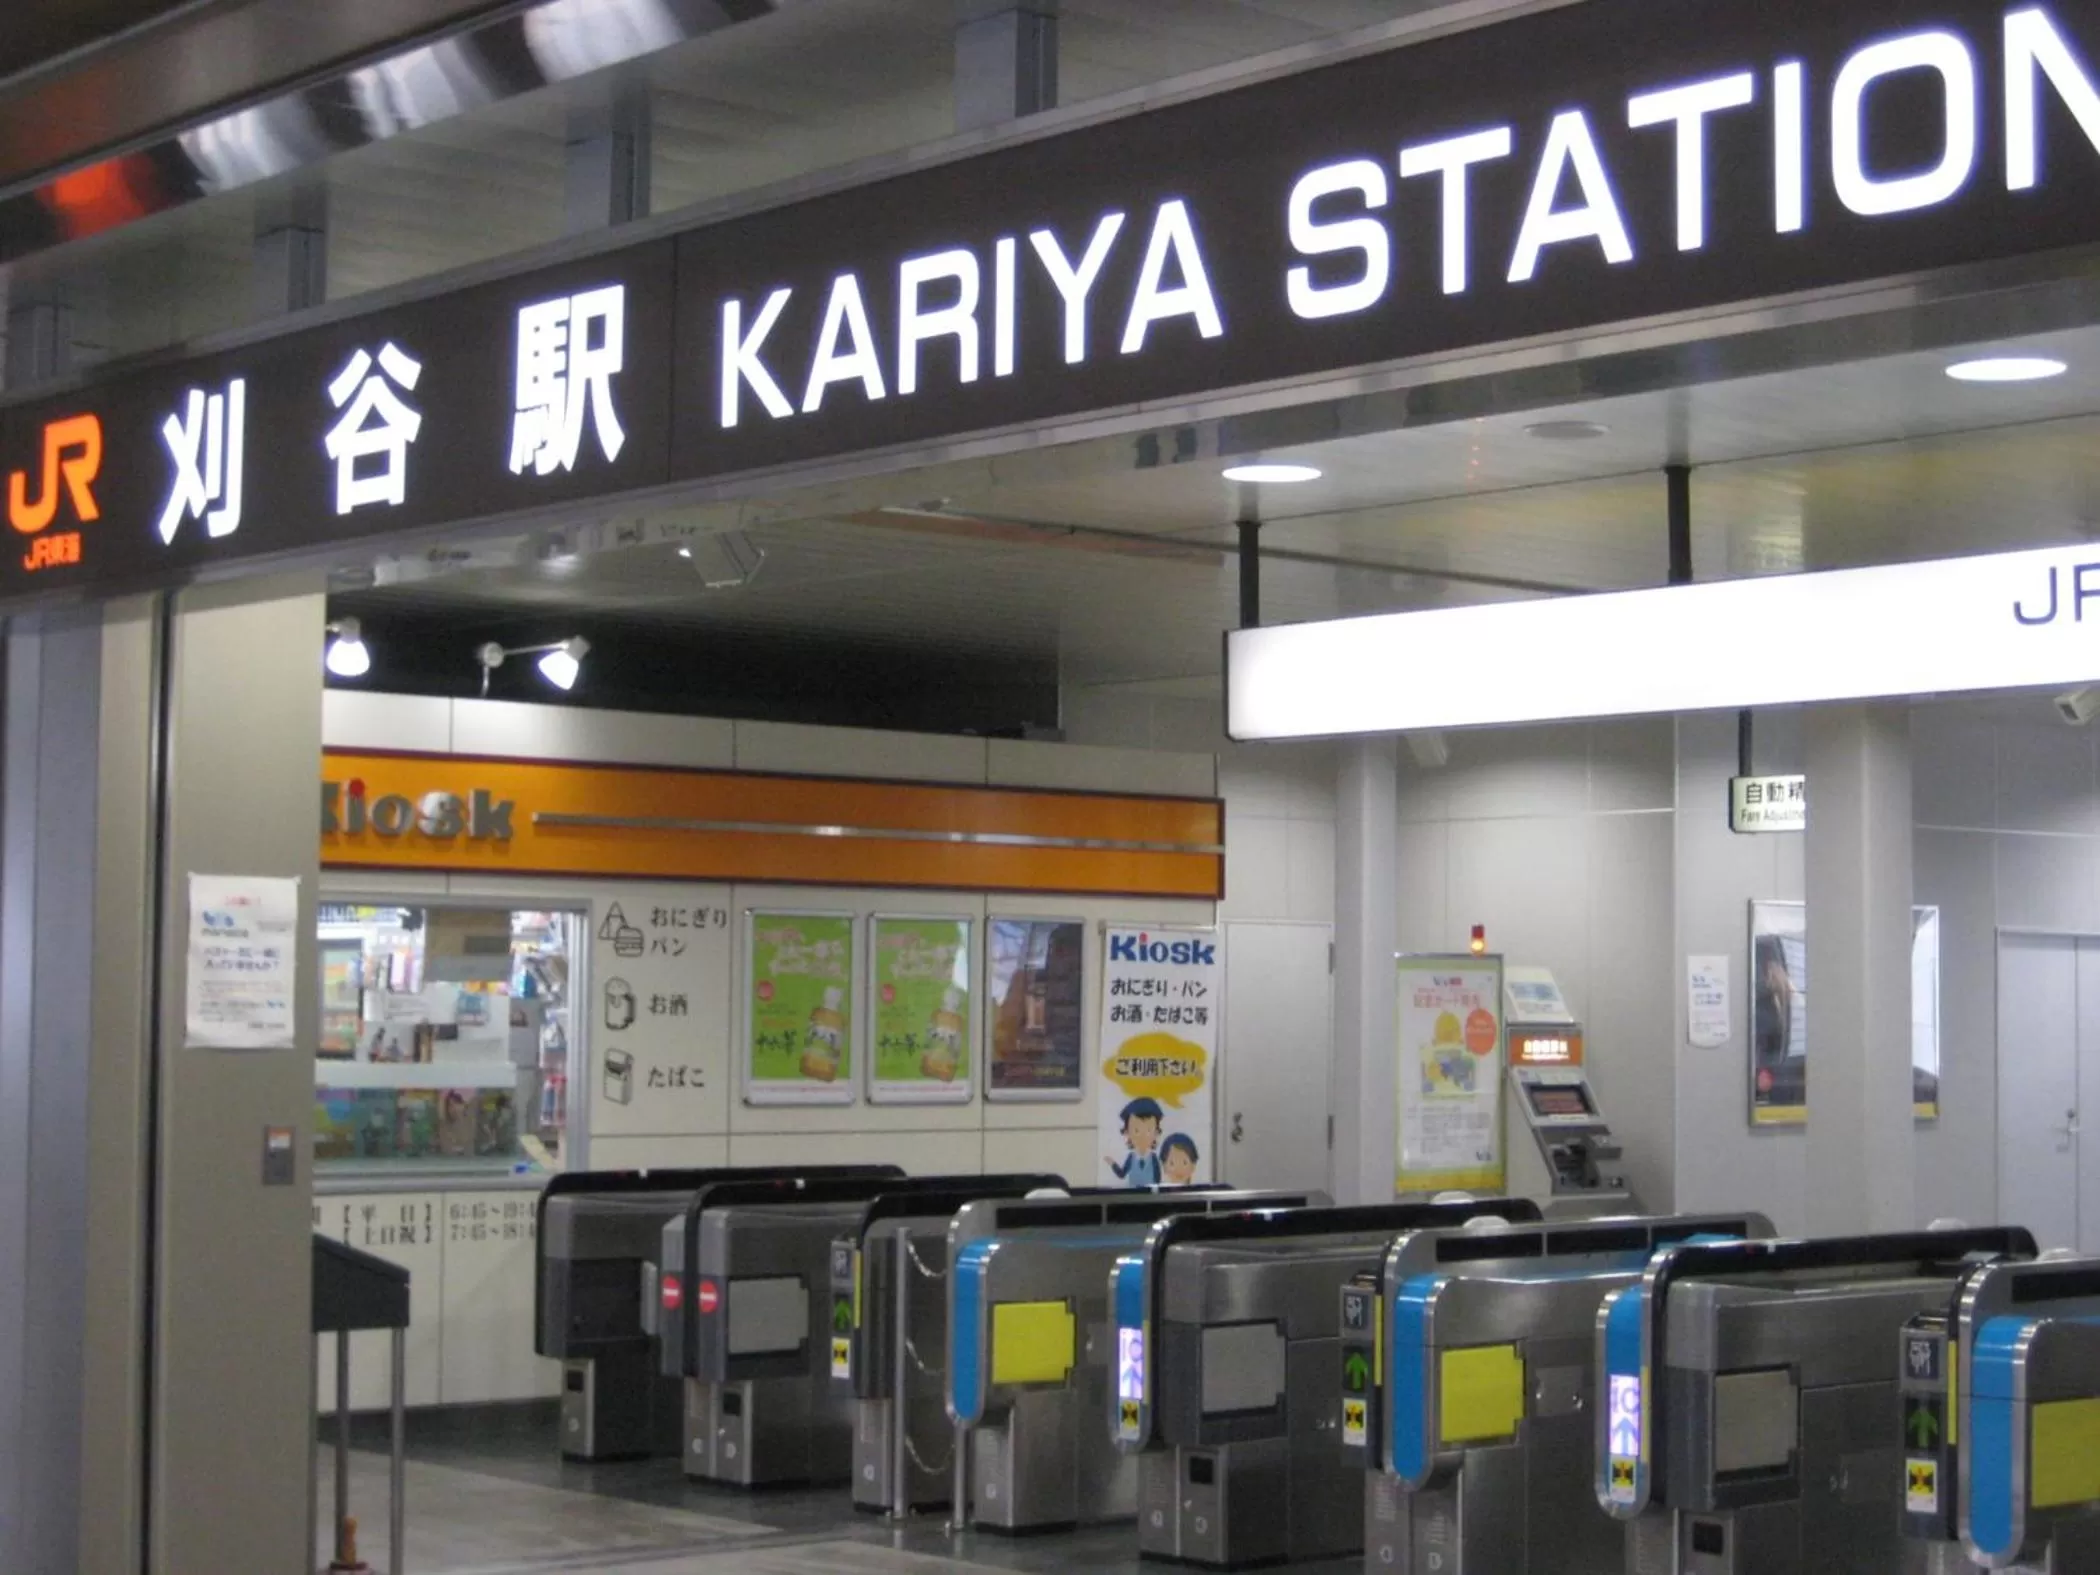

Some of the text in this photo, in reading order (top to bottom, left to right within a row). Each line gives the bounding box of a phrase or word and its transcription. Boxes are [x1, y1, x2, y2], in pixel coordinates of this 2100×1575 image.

[721, 6, 2100, 429] KARIYA STATION
[158, 284, 625, 545] 刈谷駅
[9, 414, 102, 533] JR
[650, 906, 728, 929] おにぎり
[650, 938, 687, 957] パン
[1110, 932, 1215, 966] Kiosk
[648, 994, 688, 1016] お酒
[647, 1065, 705, 1089] たばこ
